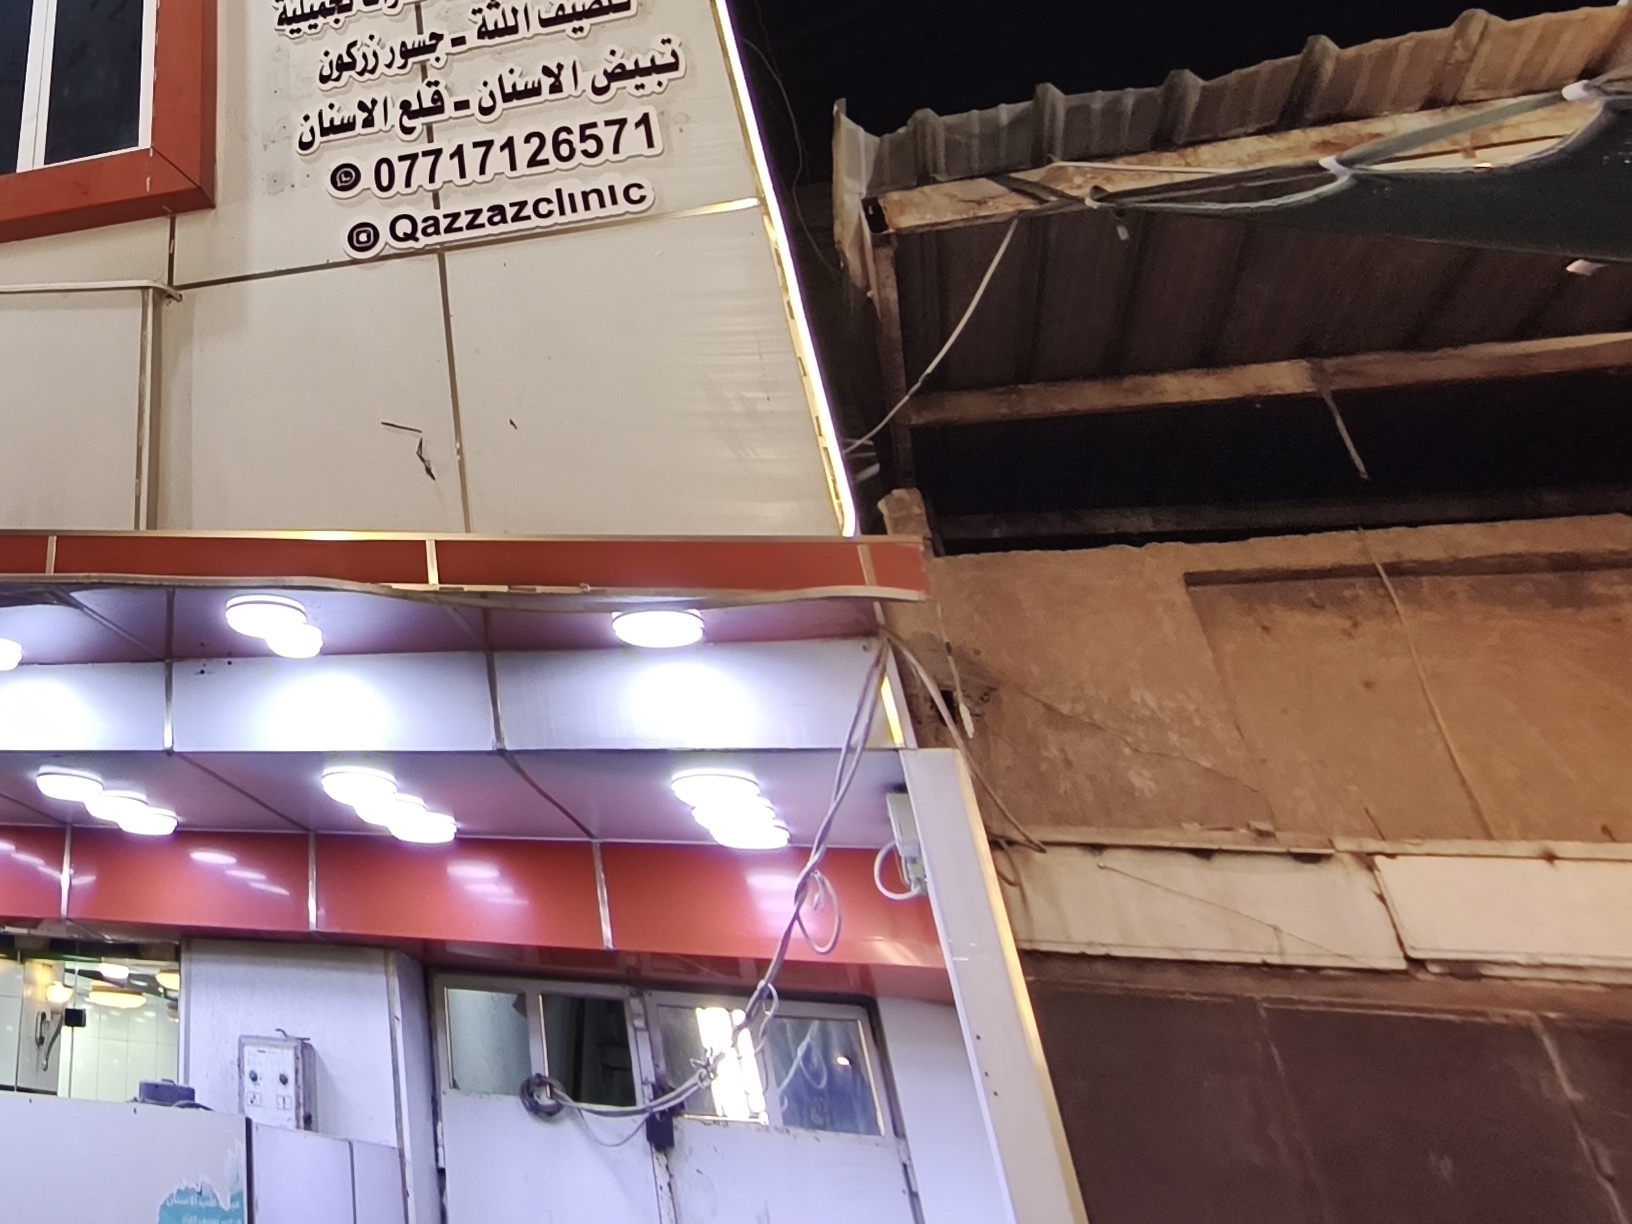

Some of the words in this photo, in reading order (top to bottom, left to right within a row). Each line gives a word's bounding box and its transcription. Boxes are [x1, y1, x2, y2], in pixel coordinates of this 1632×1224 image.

[318, 34, 379, 85] زركون
[384, 31, 444, 70] جسور
[590, 38, 680, 97] تبيض
[399, 79, 445, 135] قلع
[477, 60, 578, 117] الاسنان
[298, 96, 388, 151] الاسنان
[374, 112, 655, 193] 07717126571
[389, 182, 647, 244] Qazzazclinic
